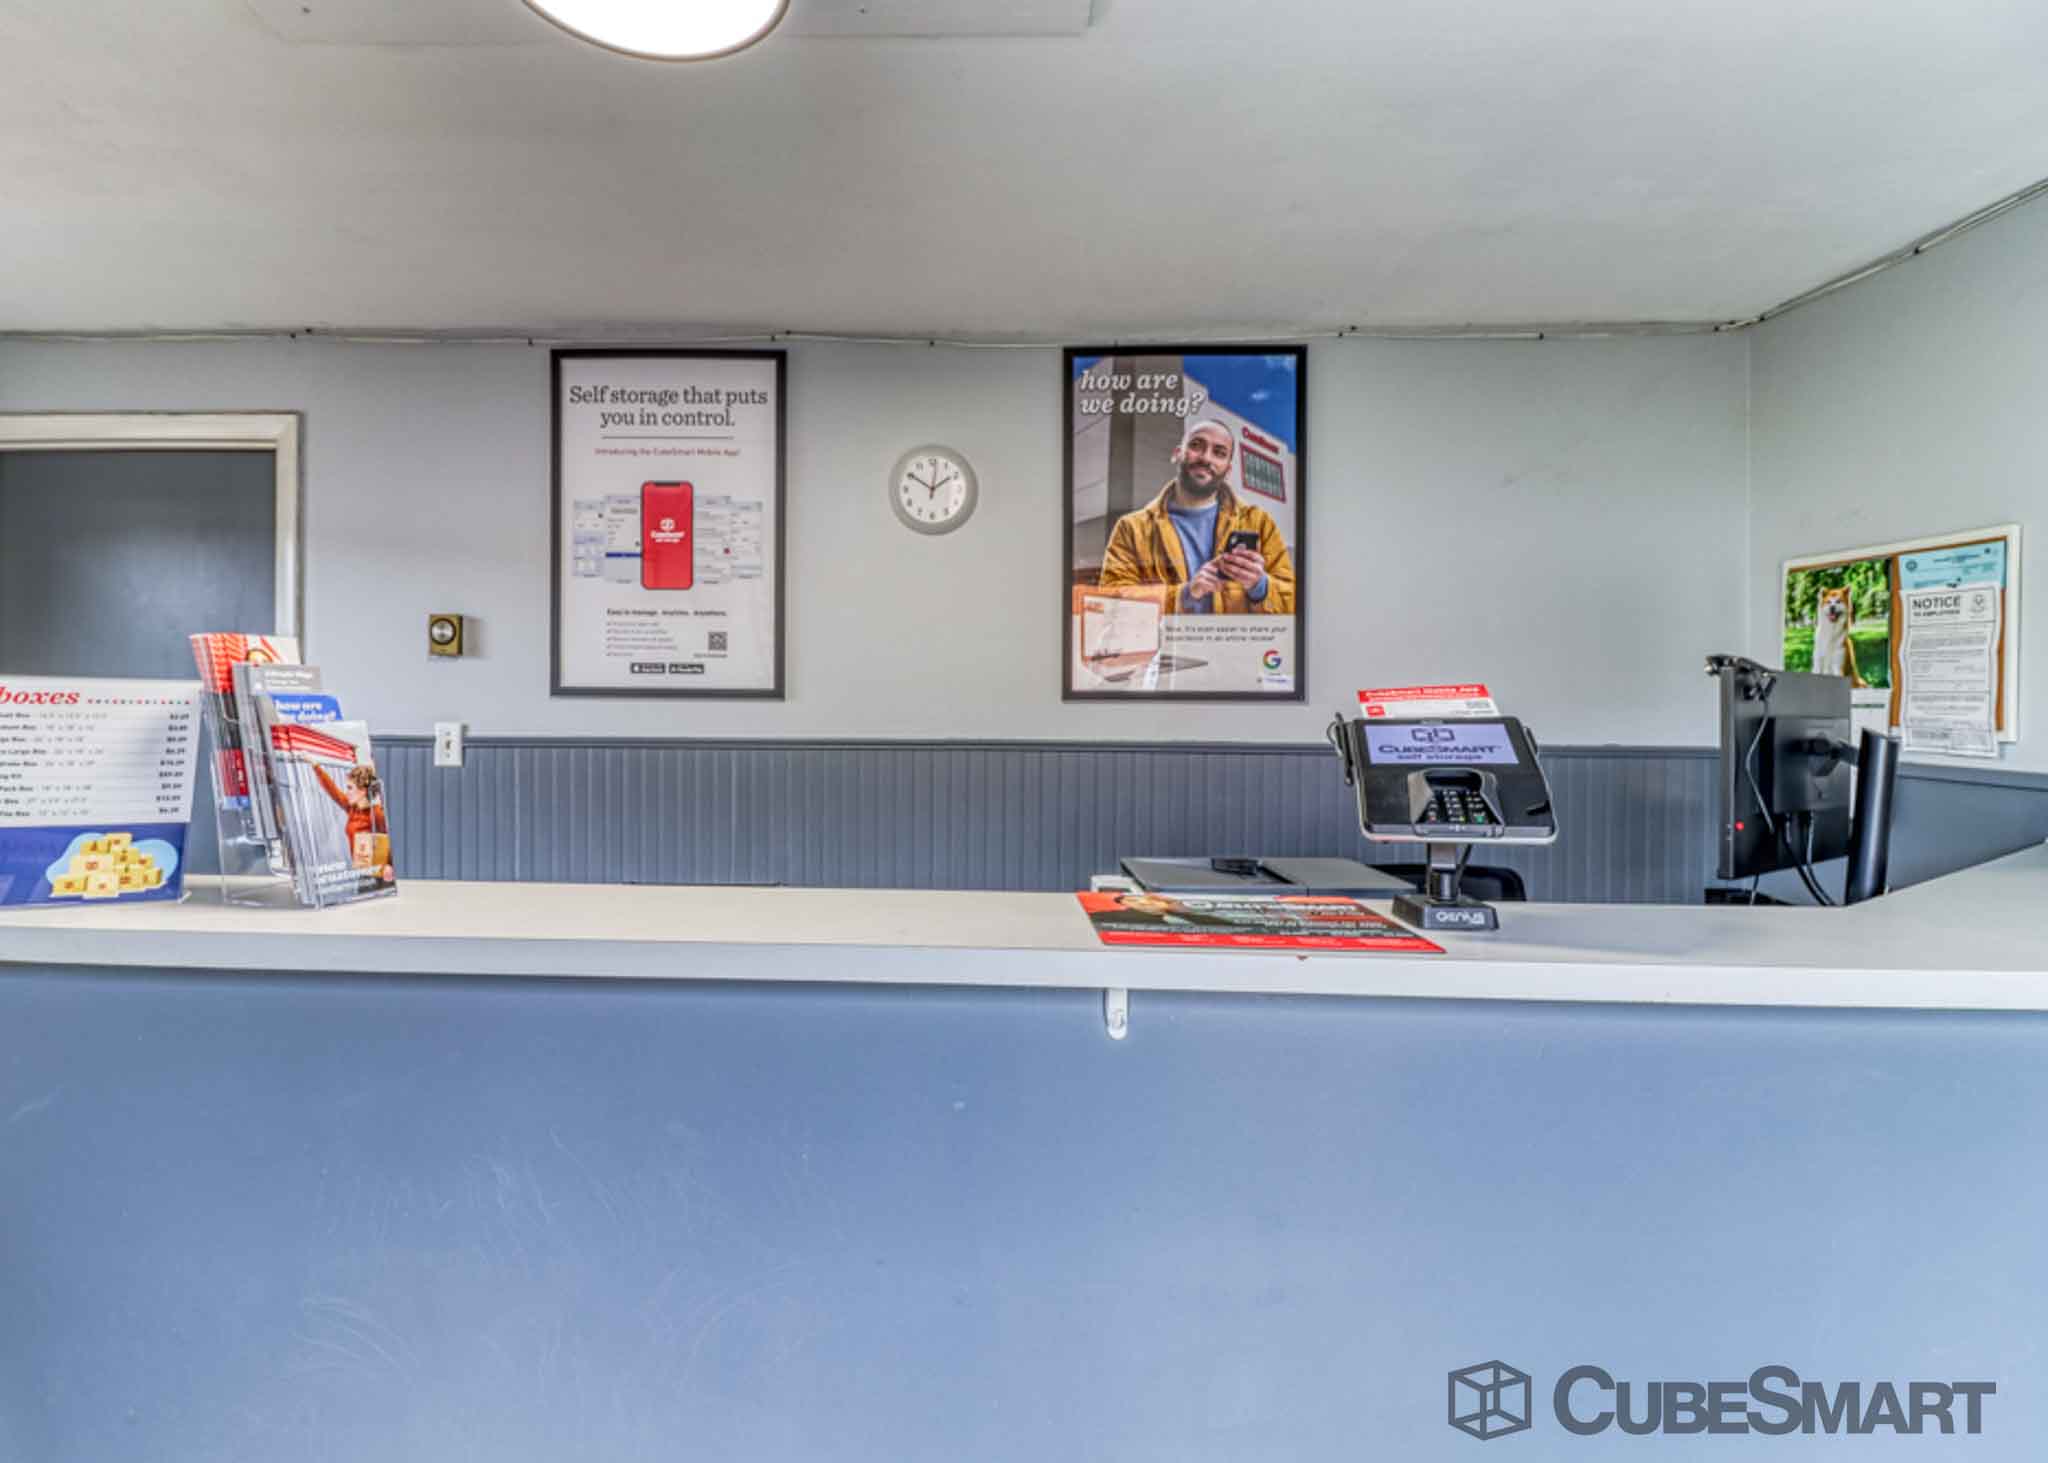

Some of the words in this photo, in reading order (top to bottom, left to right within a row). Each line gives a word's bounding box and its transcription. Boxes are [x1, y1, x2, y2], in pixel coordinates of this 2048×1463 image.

[1080, 370, 1131, 389] how
[1137, 375, 1178, 389] are
[569, 385, 609, 404] Self
[611, 388, 679, 407] storage
[683, 386, 722, 404] that
[726, 388, 769, 407] puts
[1080, 398, 1113, 413] we
[1119, 393, 1204, 418] doing?
[600, 412, 635, 429] you
[640, 408, 658, 426] in
[661, 408, 736, 427] control.
[1912, 595, 1961, 610] NOTICE
[0, 686, 80, 705] boxes
[1378, 745, 1497, 753] CUBESMART
